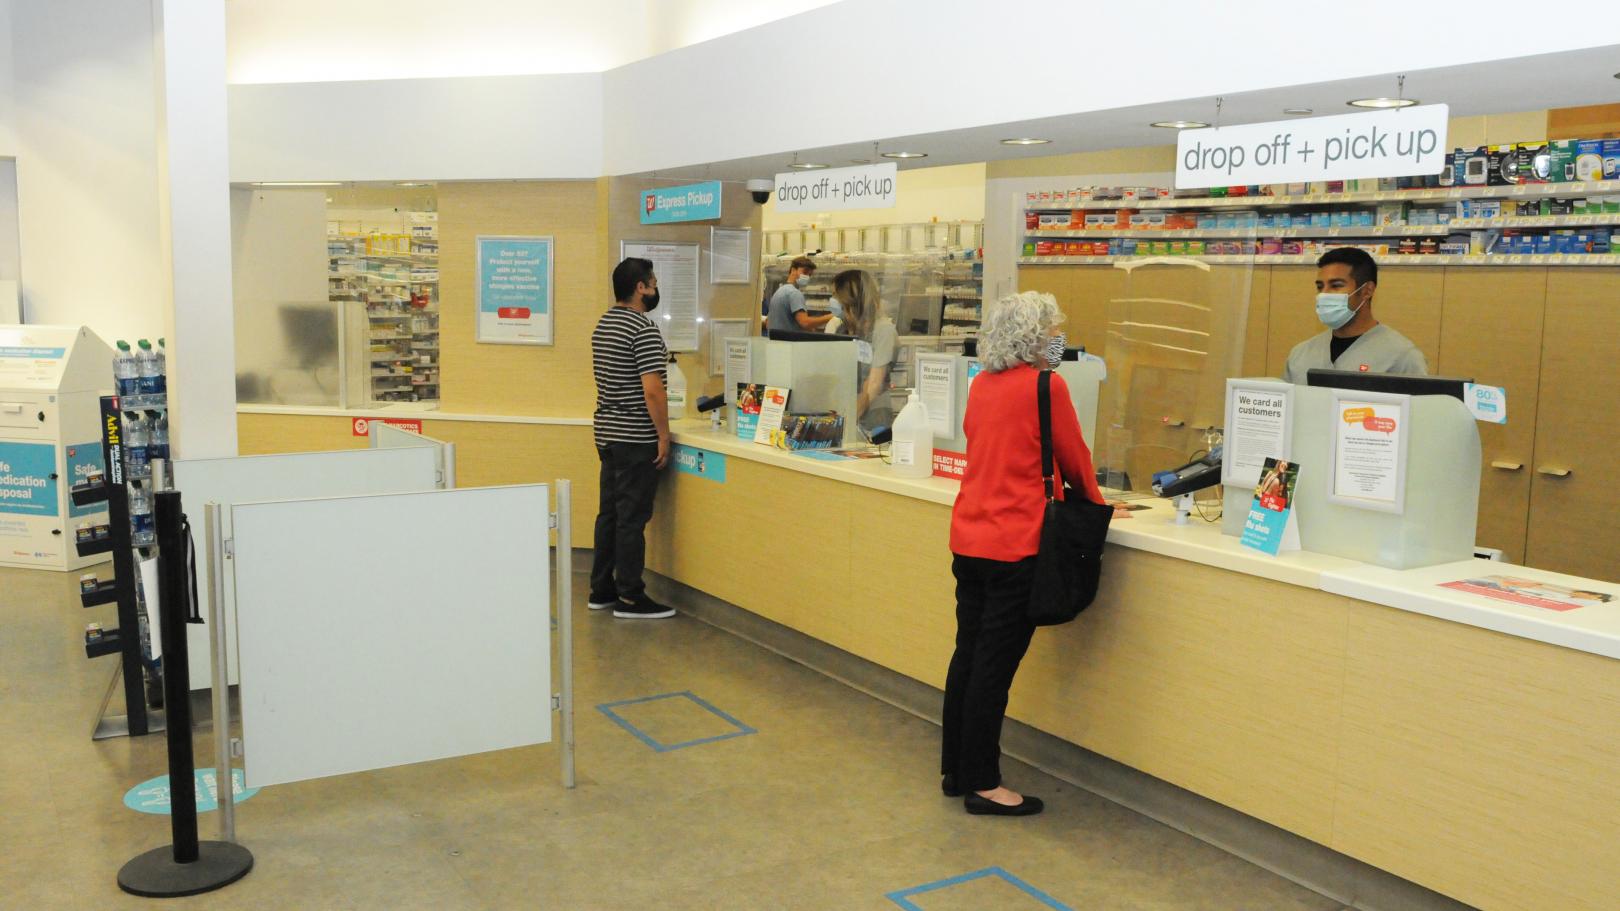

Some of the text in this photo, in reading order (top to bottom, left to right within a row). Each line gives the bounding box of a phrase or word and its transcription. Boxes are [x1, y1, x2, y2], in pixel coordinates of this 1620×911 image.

[1184, 126, 1437, 175] drop off + pick up
[779, 175, 892, 205] drop off + pick up
[657, 191, 713, 211] Express Pickup
[1239, 395, 1283, 408] We card all
[1238, 407, 1281, 418] customers
[106, 414, 120, 444] Advil
[933, 455, 953, 465] SELECT
[75, 464, 96, 476] Safe
[1249, 510, 1265, 521] FREE
[1255, 523, 1270, 534] shots
